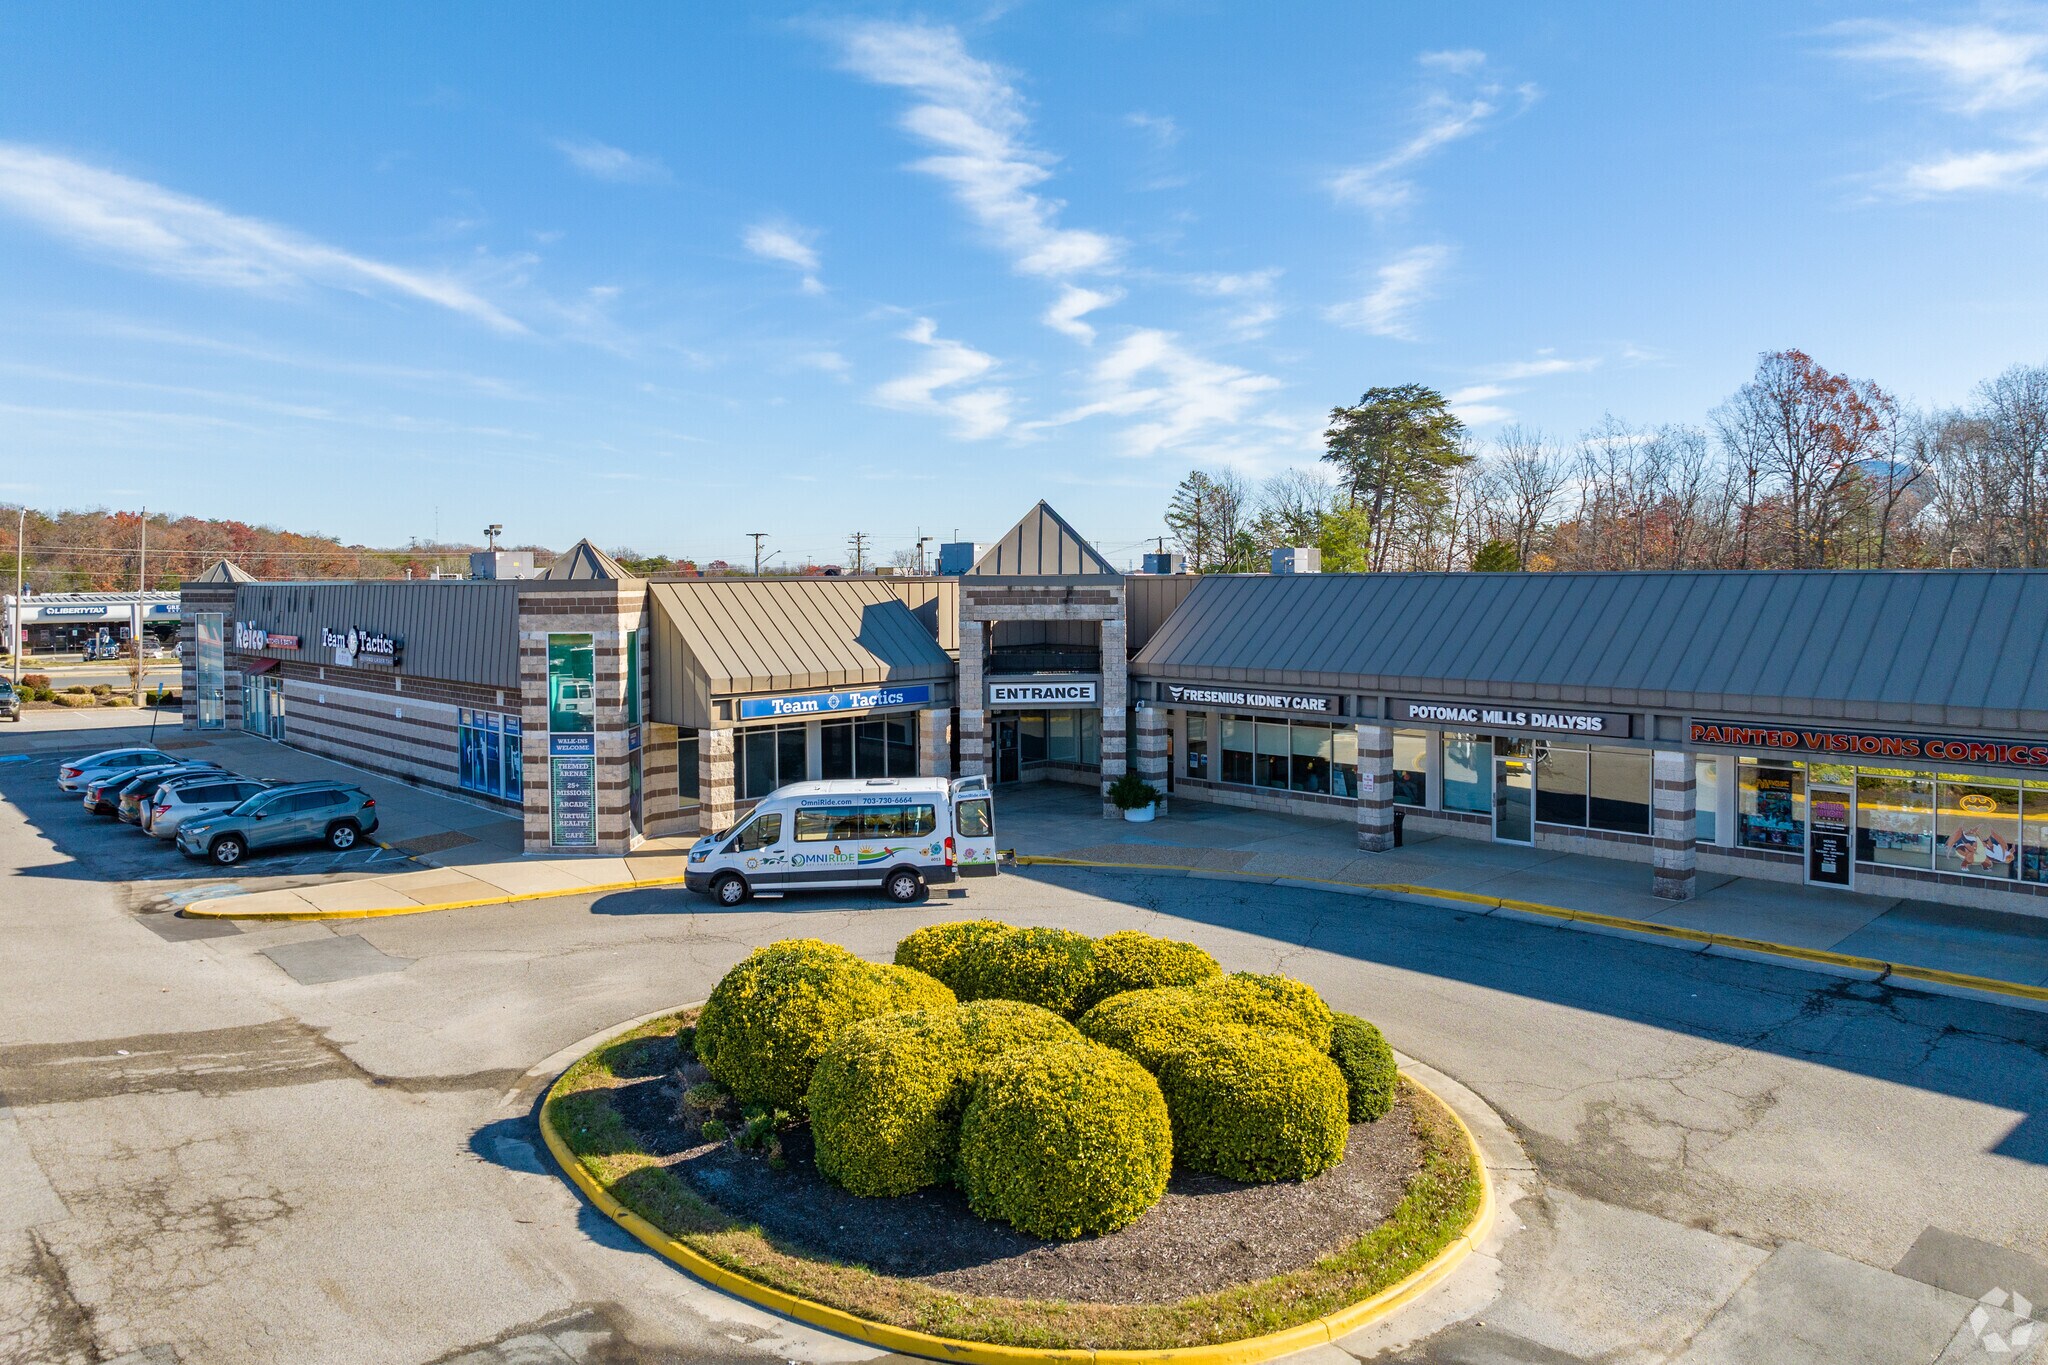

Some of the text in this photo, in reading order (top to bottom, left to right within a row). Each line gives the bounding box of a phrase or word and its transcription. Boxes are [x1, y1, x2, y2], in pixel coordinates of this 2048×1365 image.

[236, 620, 264, 650] Reico
[322, 628, 394, 653] Team Tactics
[772, 692, 904, 714] Team Tactics
[995, 687, 1090, 699] ENTRANCE
[1183, 689, 1327, 711] FRESENIUS KIDNEY CARE
[1409, 704, 1603, 731] POTOMAC MILLS DIALYSIS
[1689, 725, 2048, 765] PAINTED VISIONS COMICS
[801, 798, 852, 806] OmniRide.com
[863, 796, 912, 804] 703-730-6664
[957, 791, 989, 799] OmniRide.com
